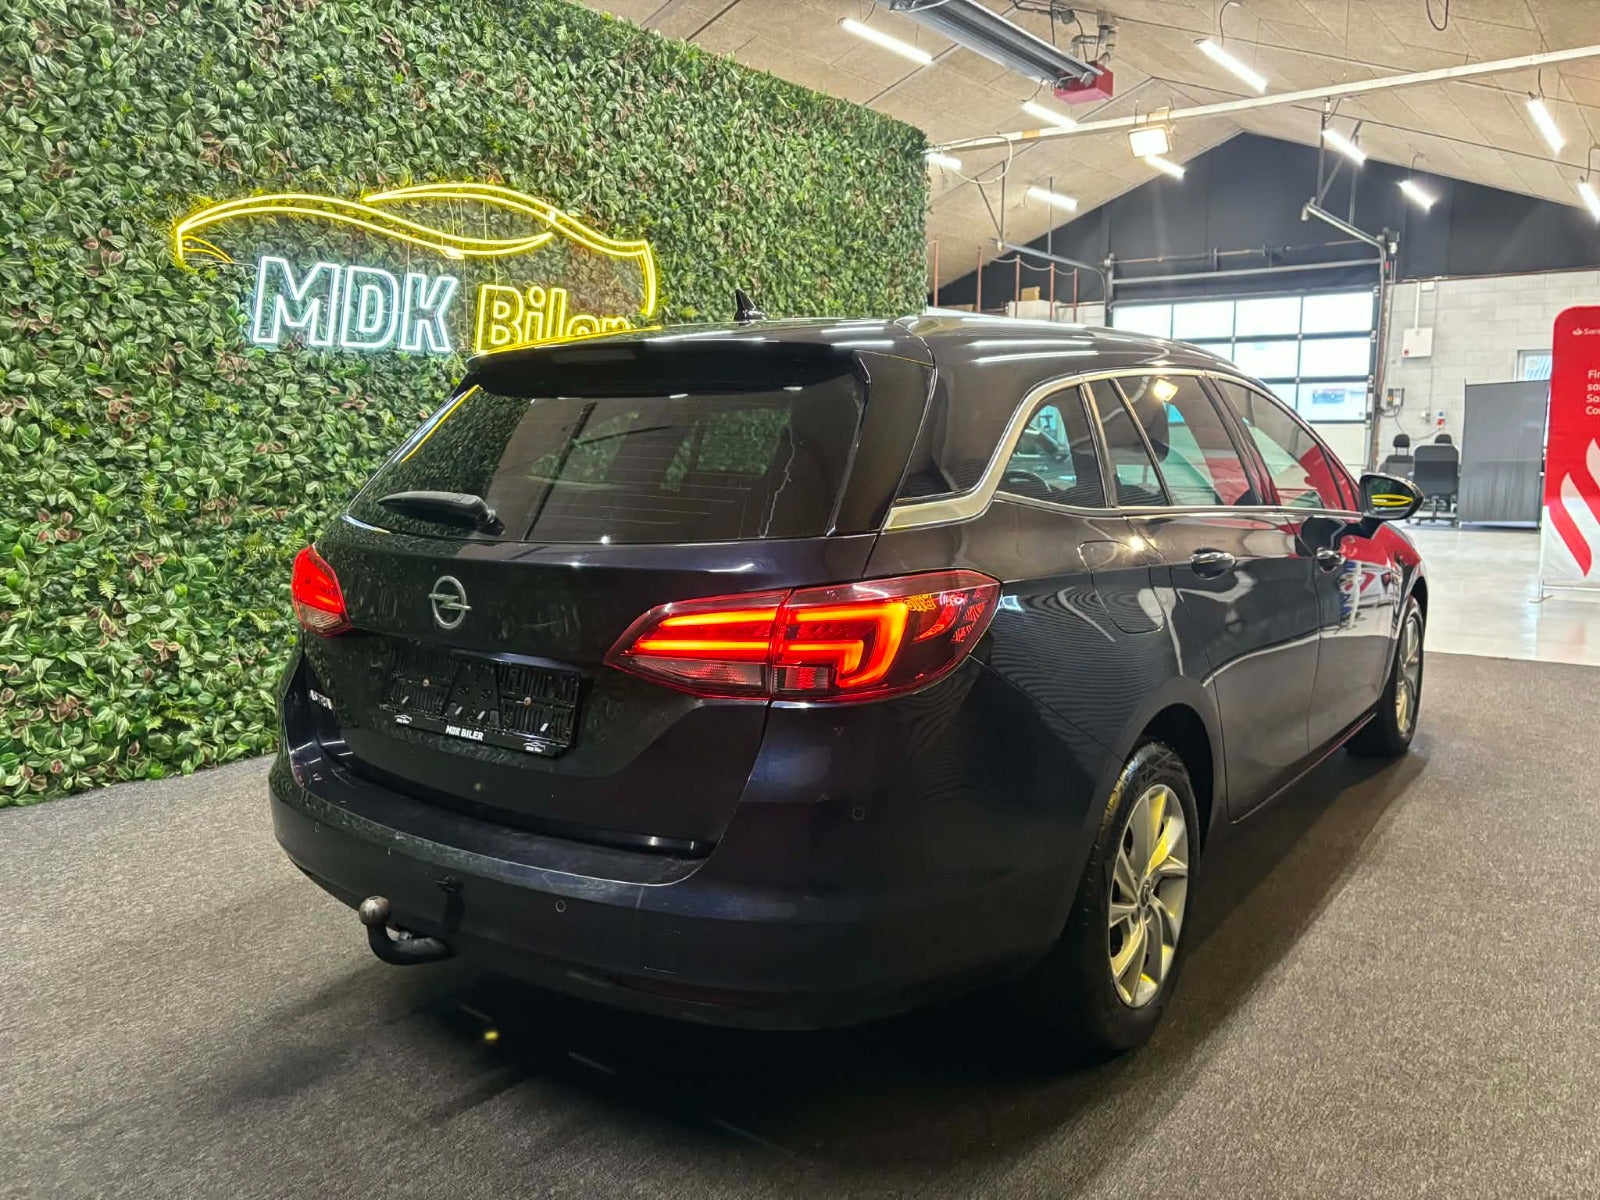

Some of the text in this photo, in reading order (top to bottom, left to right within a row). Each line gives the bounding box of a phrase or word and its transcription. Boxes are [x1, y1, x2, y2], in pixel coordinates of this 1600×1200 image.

[252, 255, 457, 351] MDK
[1586, 394, 1600, 403] Sa
[1585, 406, 1600, 415] Co
[461, 728, 484, 741] BILER
